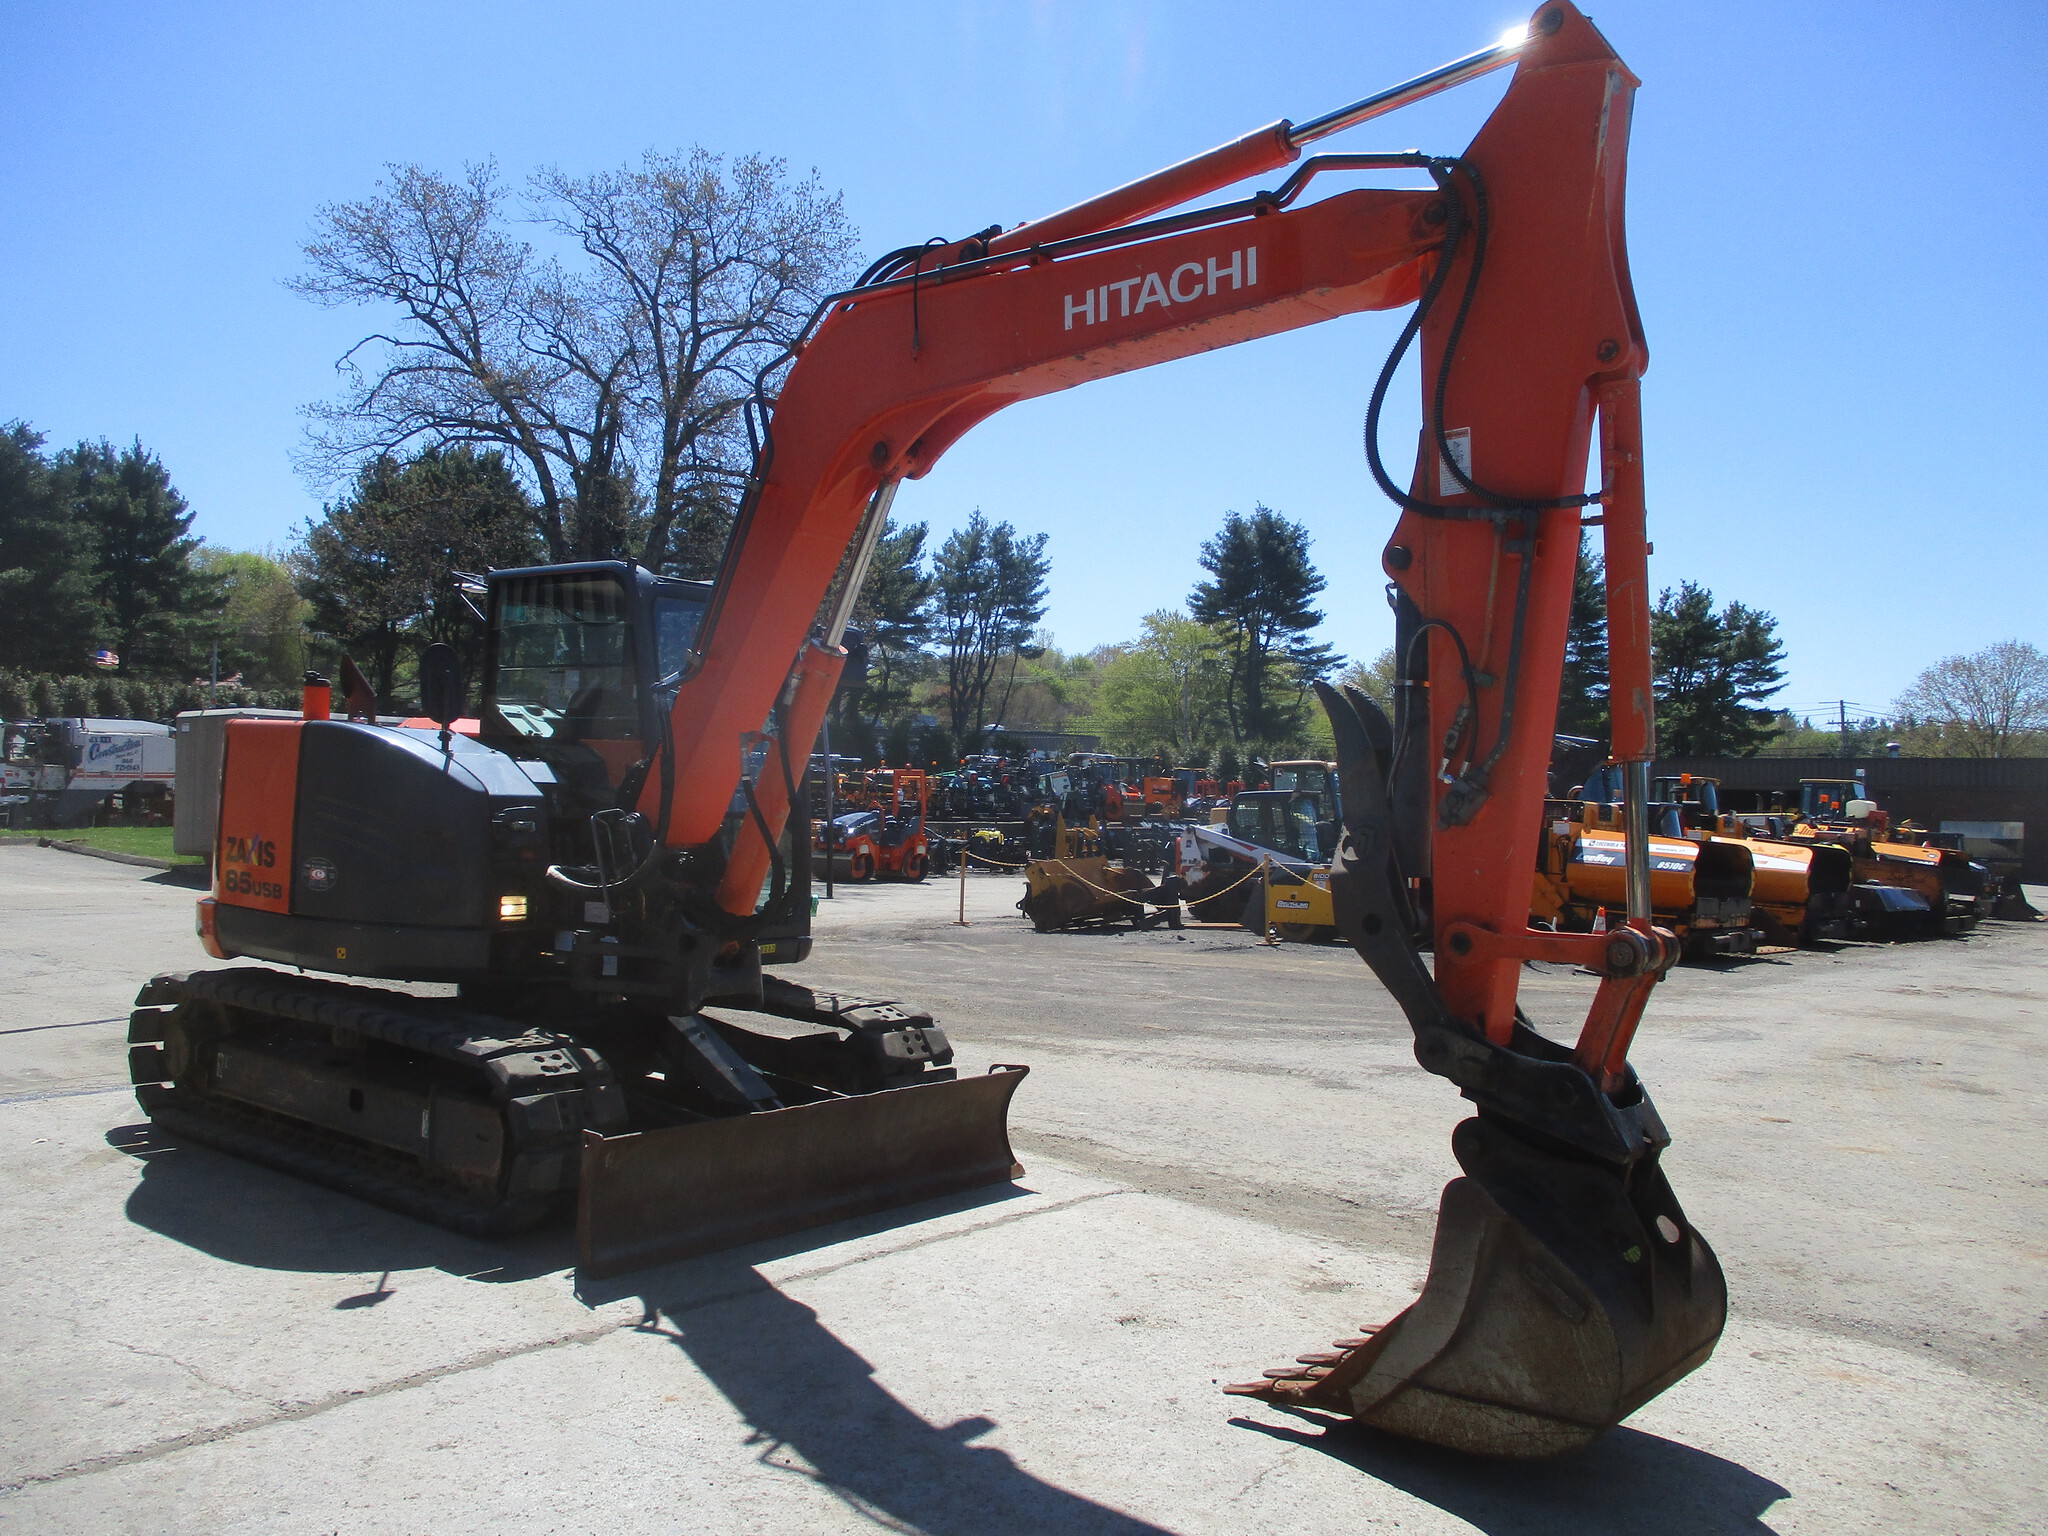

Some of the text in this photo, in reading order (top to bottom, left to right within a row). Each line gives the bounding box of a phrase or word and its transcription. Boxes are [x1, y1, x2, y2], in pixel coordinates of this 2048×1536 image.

[1064, 246, 1257, 331] HITACHI
[87, 737, 141, 761] Construction
[226, 834, 276, 868] ZAXIS
[1576, 853, 1615, 866] LeeBoy
[1657, 861, 1687, 871] 8510C
